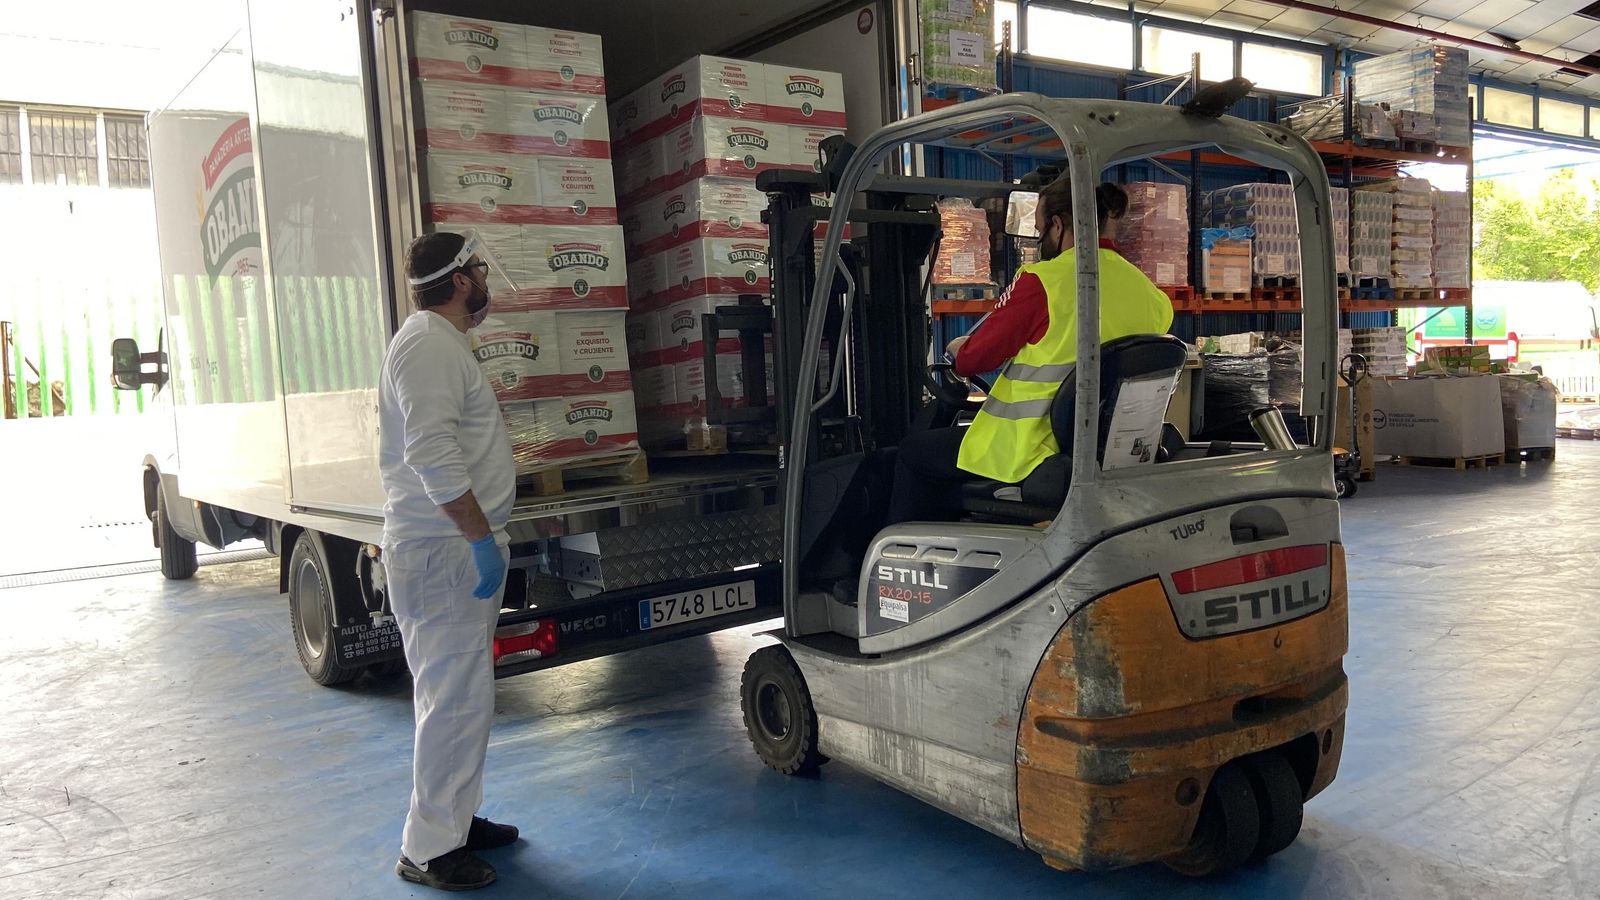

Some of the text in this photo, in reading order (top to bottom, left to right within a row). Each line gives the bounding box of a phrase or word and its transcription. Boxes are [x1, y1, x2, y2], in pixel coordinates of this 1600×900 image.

[449, 30, 495, 47] OBANDO
[789, 82, 821, 95] OBANDO
[538, 107, 580, 121] OBANDO
[731, 135, 766, 147] OBANDO
[463, 173, 508, 187] OBANDO
[206, 177, 259, 267] OBAN
[553, 253, 604, 268] OBANDO
[731, 250, 767, 261] OBANDO
[576, 338, 610, 346] EXQUISITO
[479, 341, 534, 360] OBANDO
[579, 347, 614, 355] CRUJIENTE
[570, 409, 609, 421] OBANDO
[878, 565, 948, 590] STILL
[652, 585, 749, 623] 5748 LCL
[1204, 580, 1319, 628] STILL
[341, 624, 367, 636] AUTO
[557, 615, 608, 633] VECO
[358, 625, 400, 641] HISPALIS
